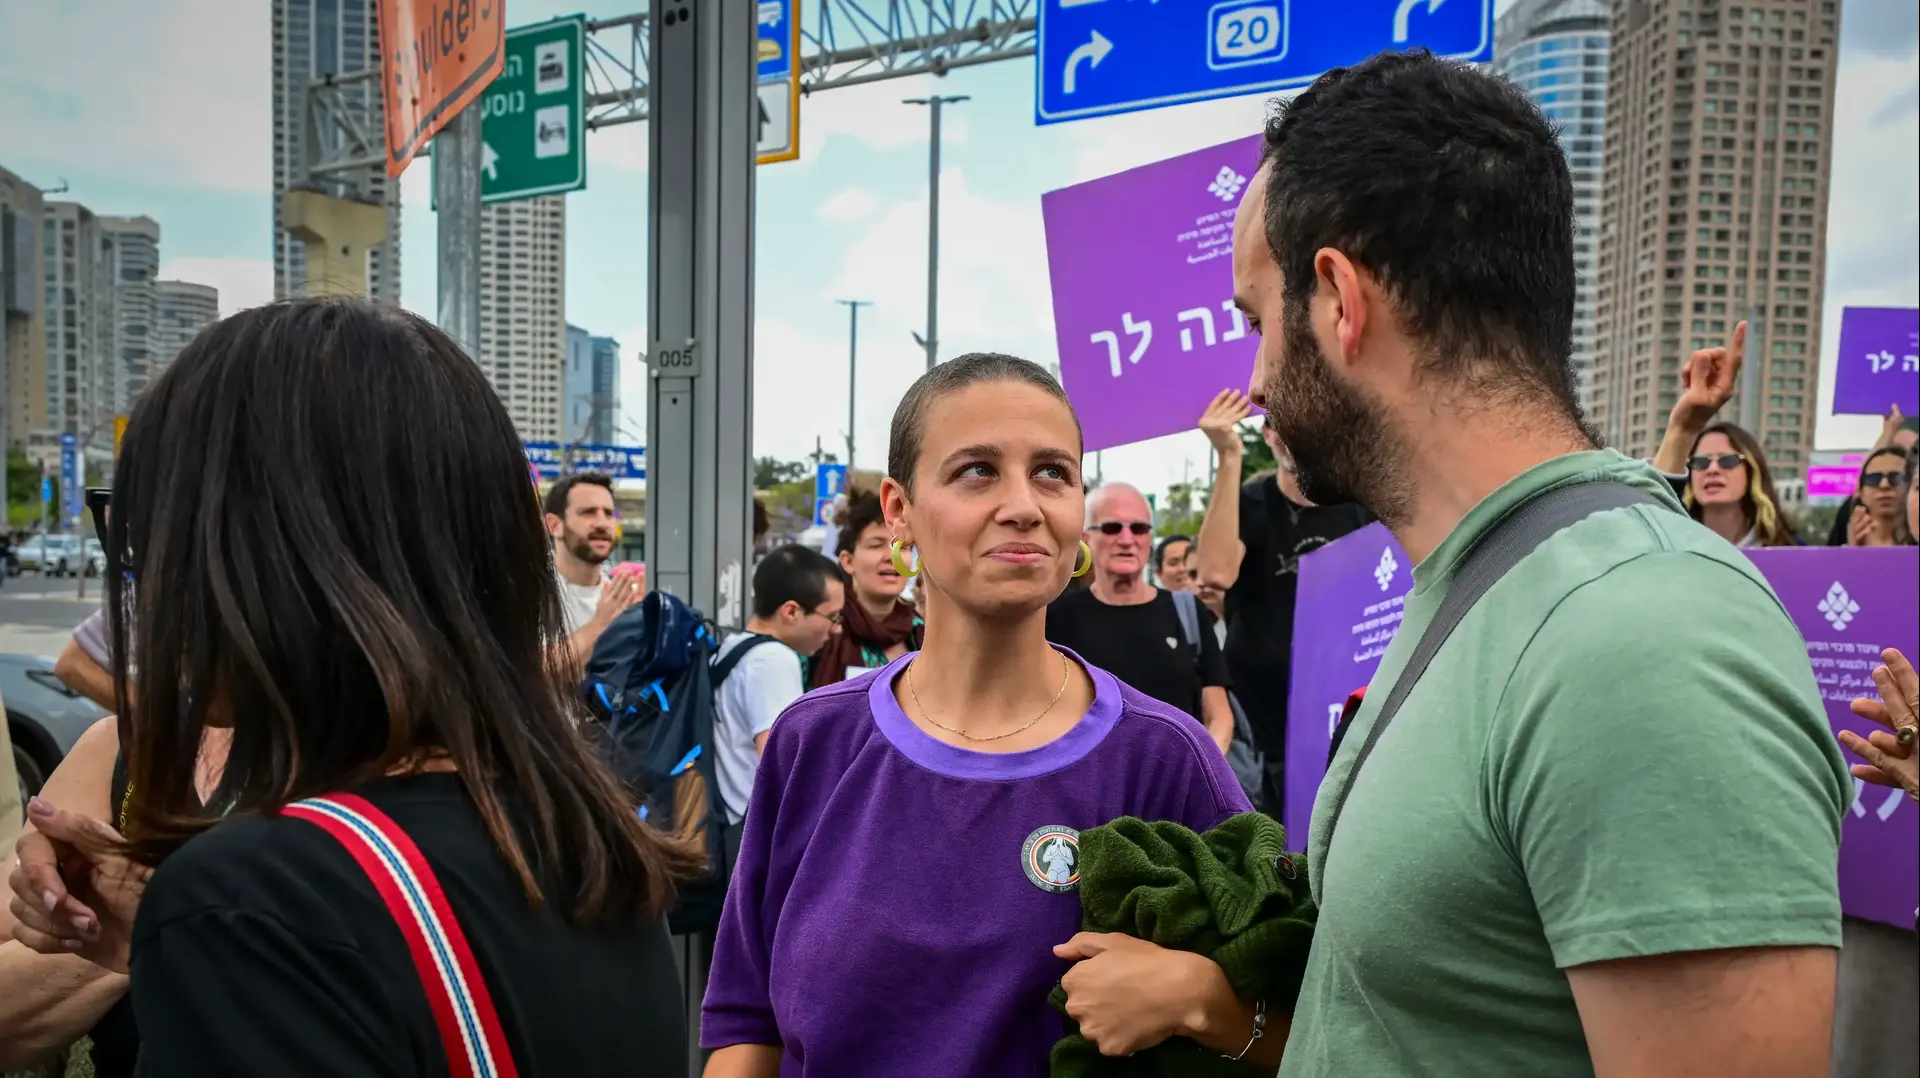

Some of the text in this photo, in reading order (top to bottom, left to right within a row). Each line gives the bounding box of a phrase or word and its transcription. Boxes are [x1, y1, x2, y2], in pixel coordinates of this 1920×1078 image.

[1226, 16, 1269, 48] 20
[480, 90, 525, 120] נוסע
[1090, 299, 1246, 378] נה לך
[659, 350, 693, 368] 005
[1866, 350, 1895, 374] לך
